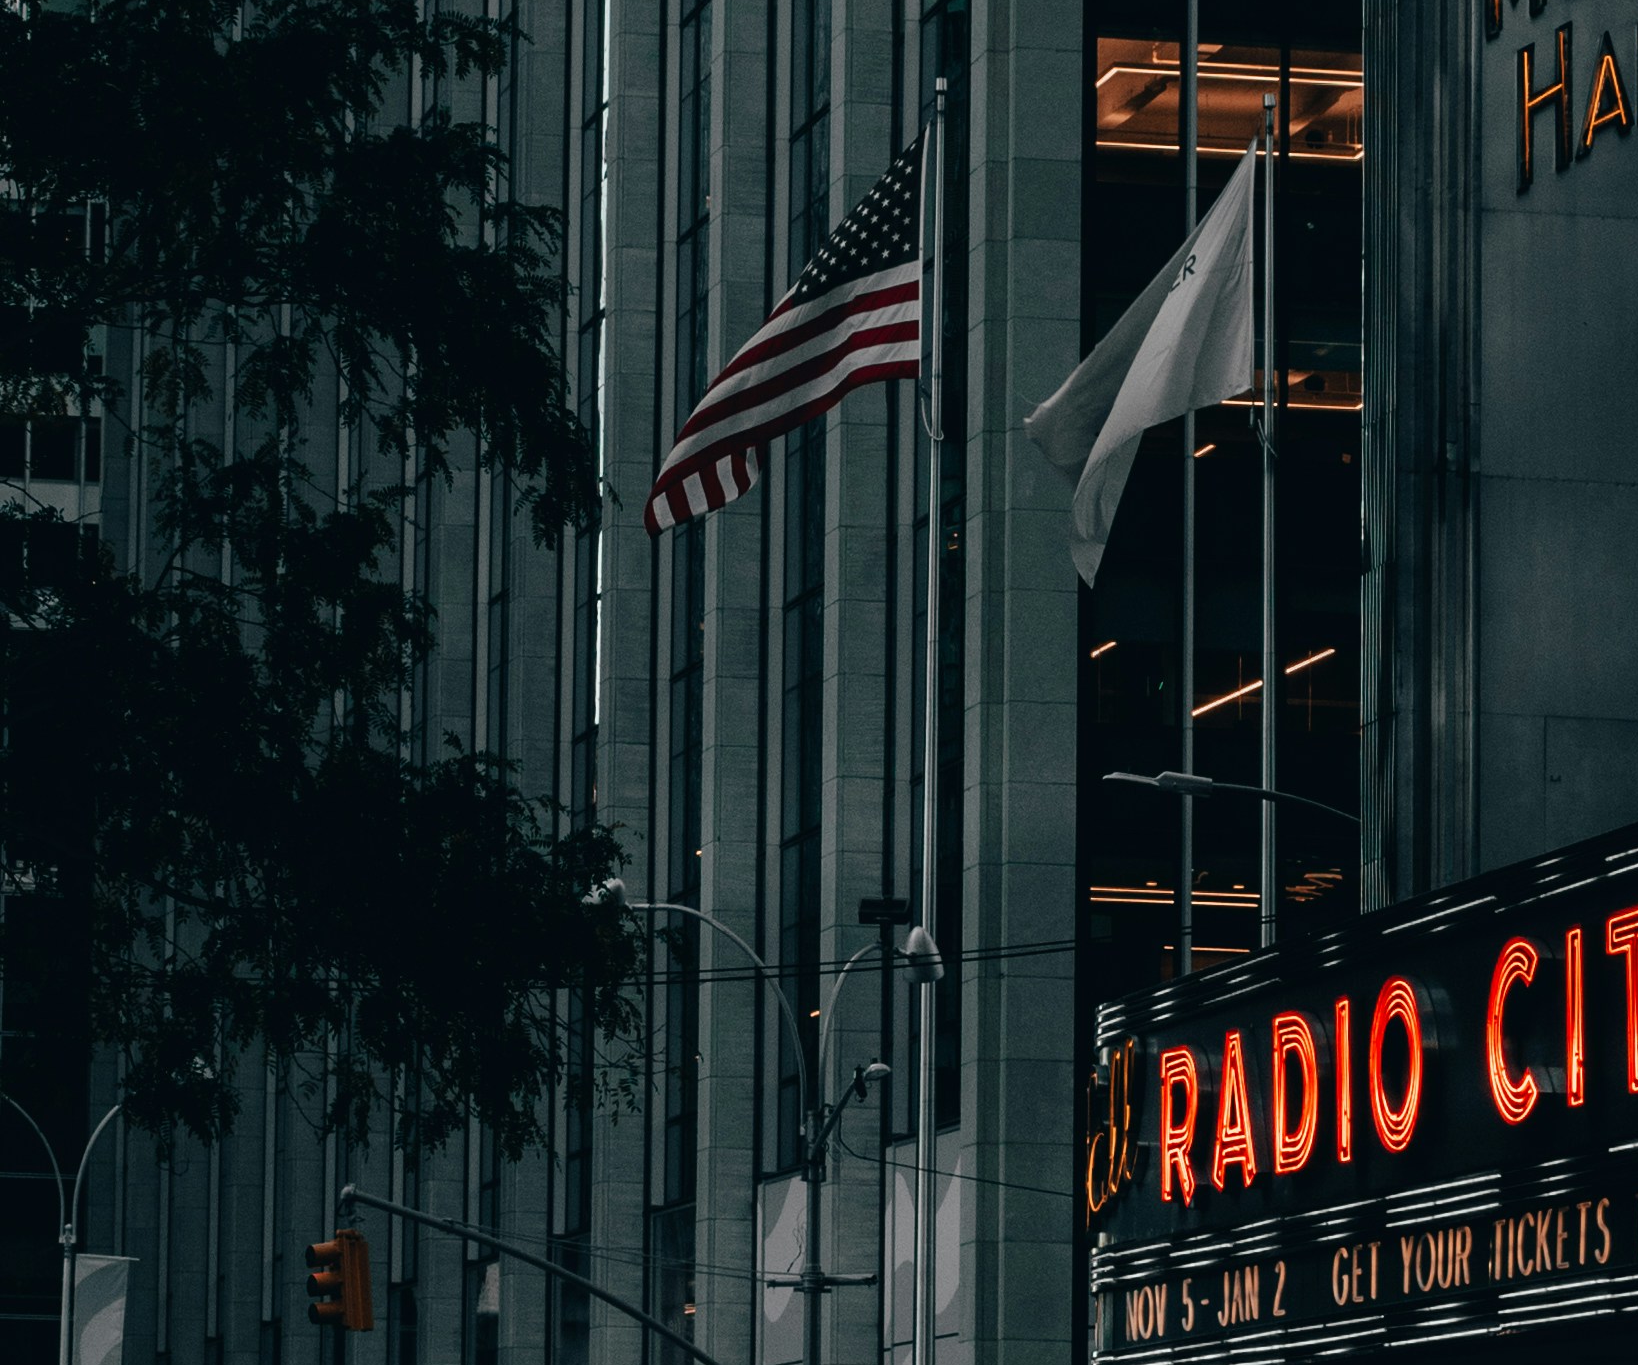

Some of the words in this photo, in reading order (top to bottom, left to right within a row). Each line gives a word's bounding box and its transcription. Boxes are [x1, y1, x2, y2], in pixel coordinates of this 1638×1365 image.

[1160, 975, 1423, 1207] RADIO
[1125, 1283, 1167, 1342] NOV
[1272, 1260, 1287, 1318] 2
[1332, 1241, 1381, 1306] GET
[1400, 1226, 1472, 1295] YOUR
[1490, 1197, 1611, 1284] TICKETS
